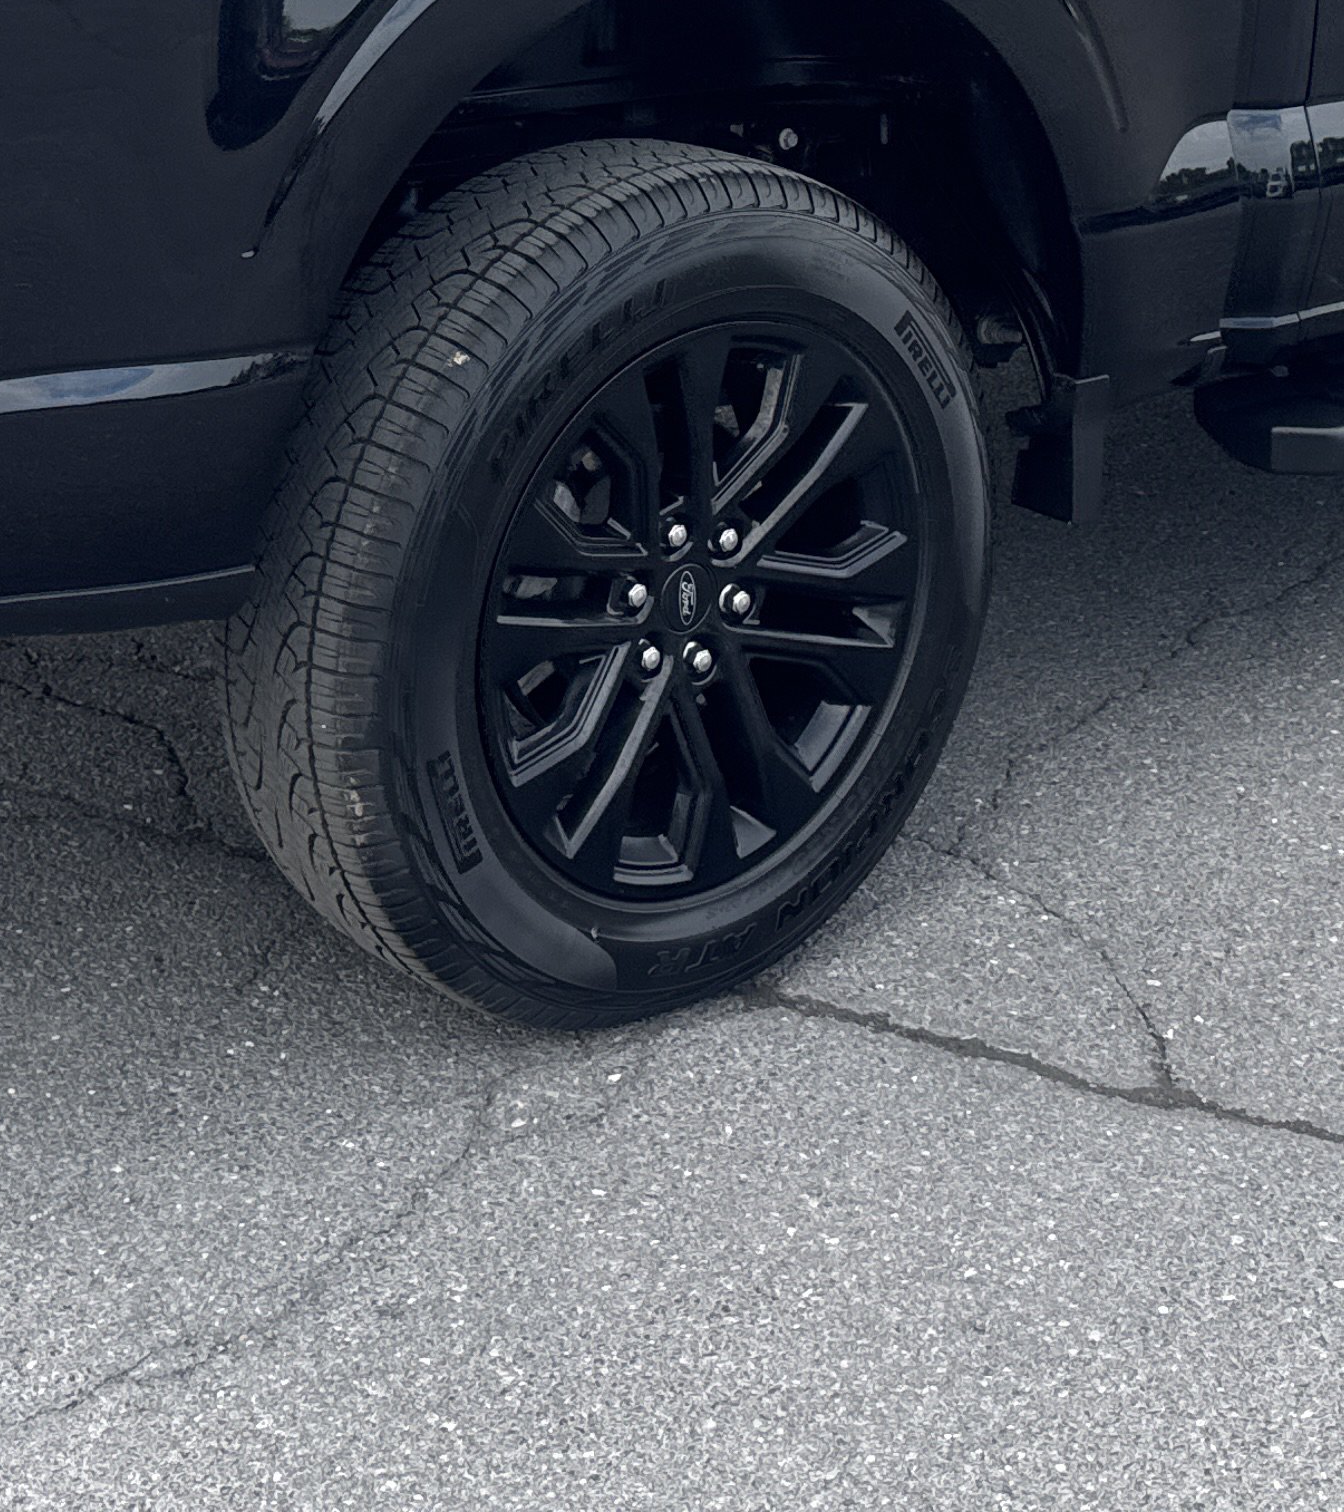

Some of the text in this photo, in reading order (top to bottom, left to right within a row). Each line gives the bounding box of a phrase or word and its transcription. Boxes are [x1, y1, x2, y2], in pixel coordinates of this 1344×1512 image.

[894, 310, 956, 409] PIRELLI
[680, 580, 695, 618] Ford
[426, 750, 483, 874] PIRELLI
